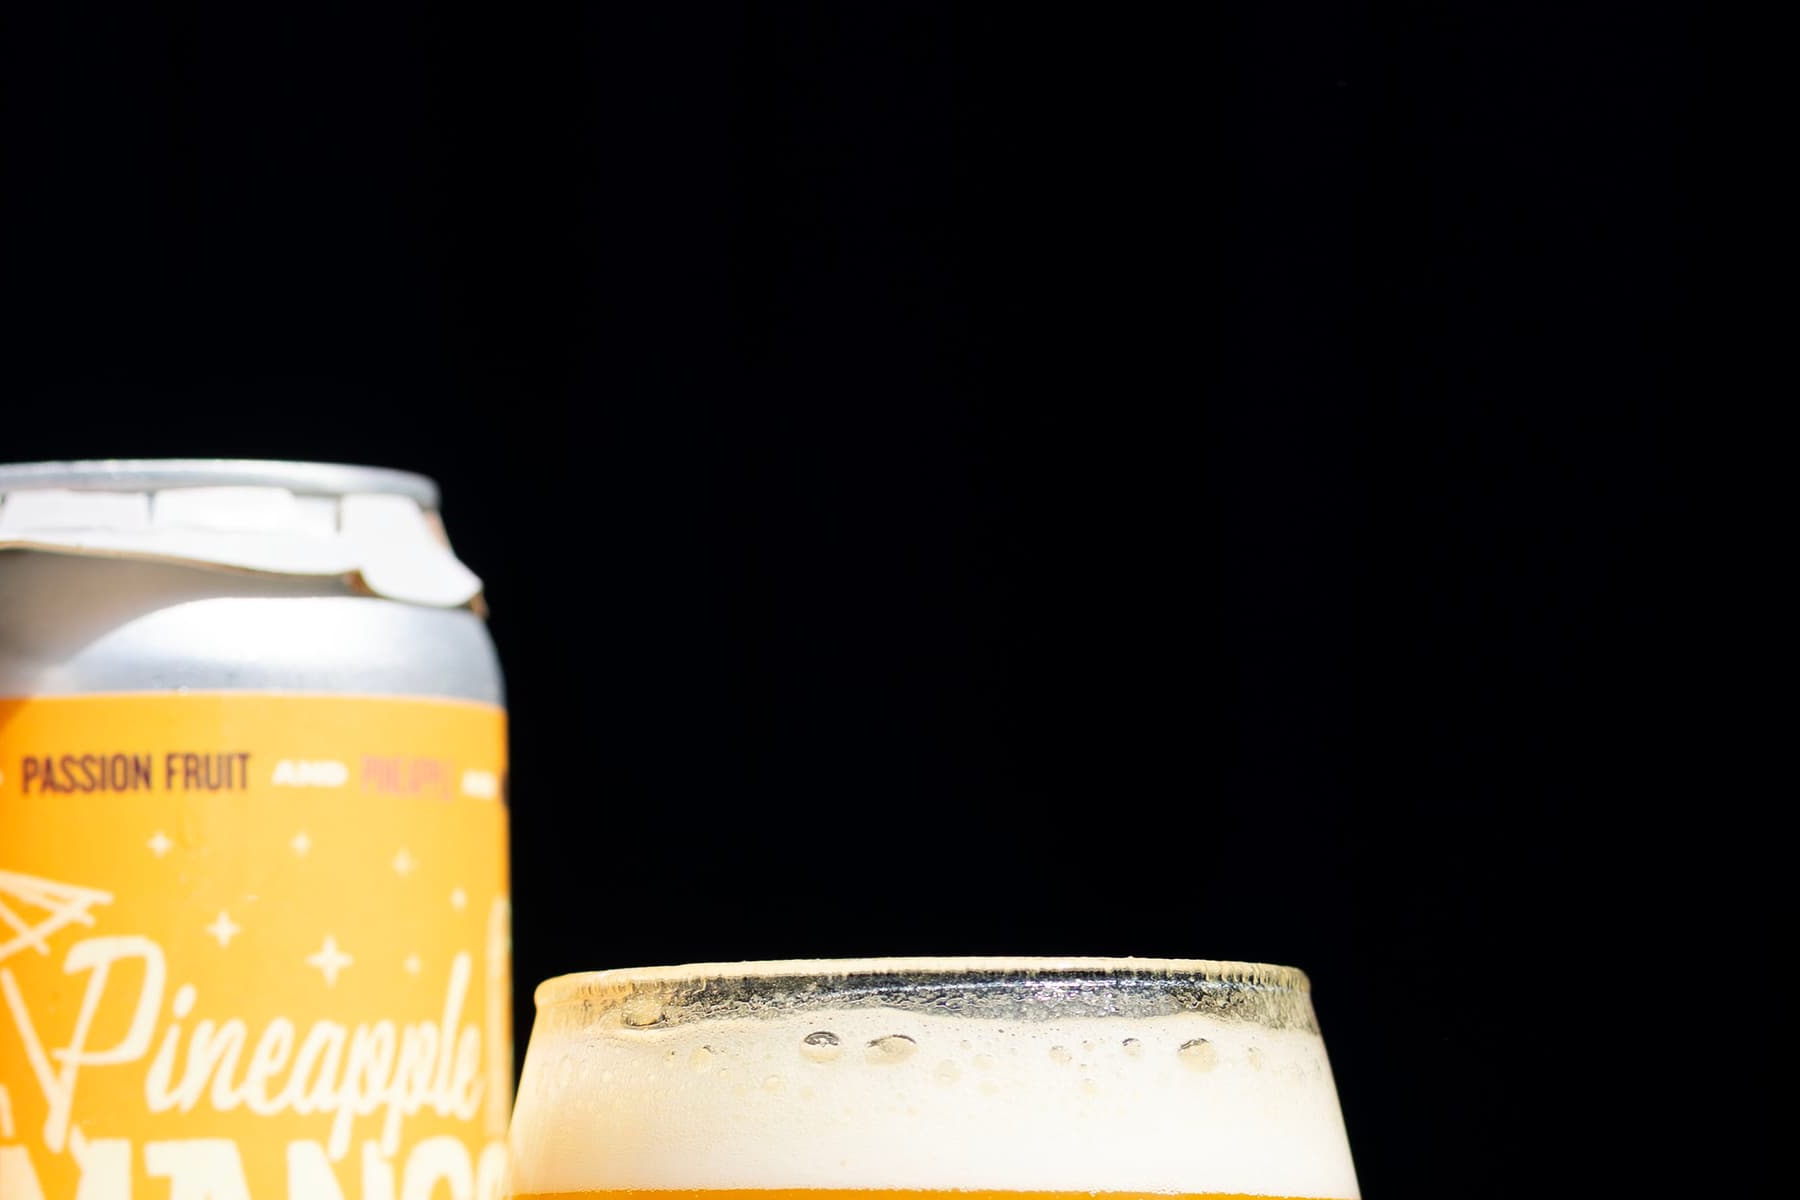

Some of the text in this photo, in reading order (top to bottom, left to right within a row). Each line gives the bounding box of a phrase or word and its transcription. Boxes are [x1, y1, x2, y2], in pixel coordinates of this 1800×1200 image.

[22, 754, 152, 796] PASSION
[165, 752, 250, 792] FRUIT
[272, 760, 348, 787] AND
[45, 935, 484, 1161] Pineapple
